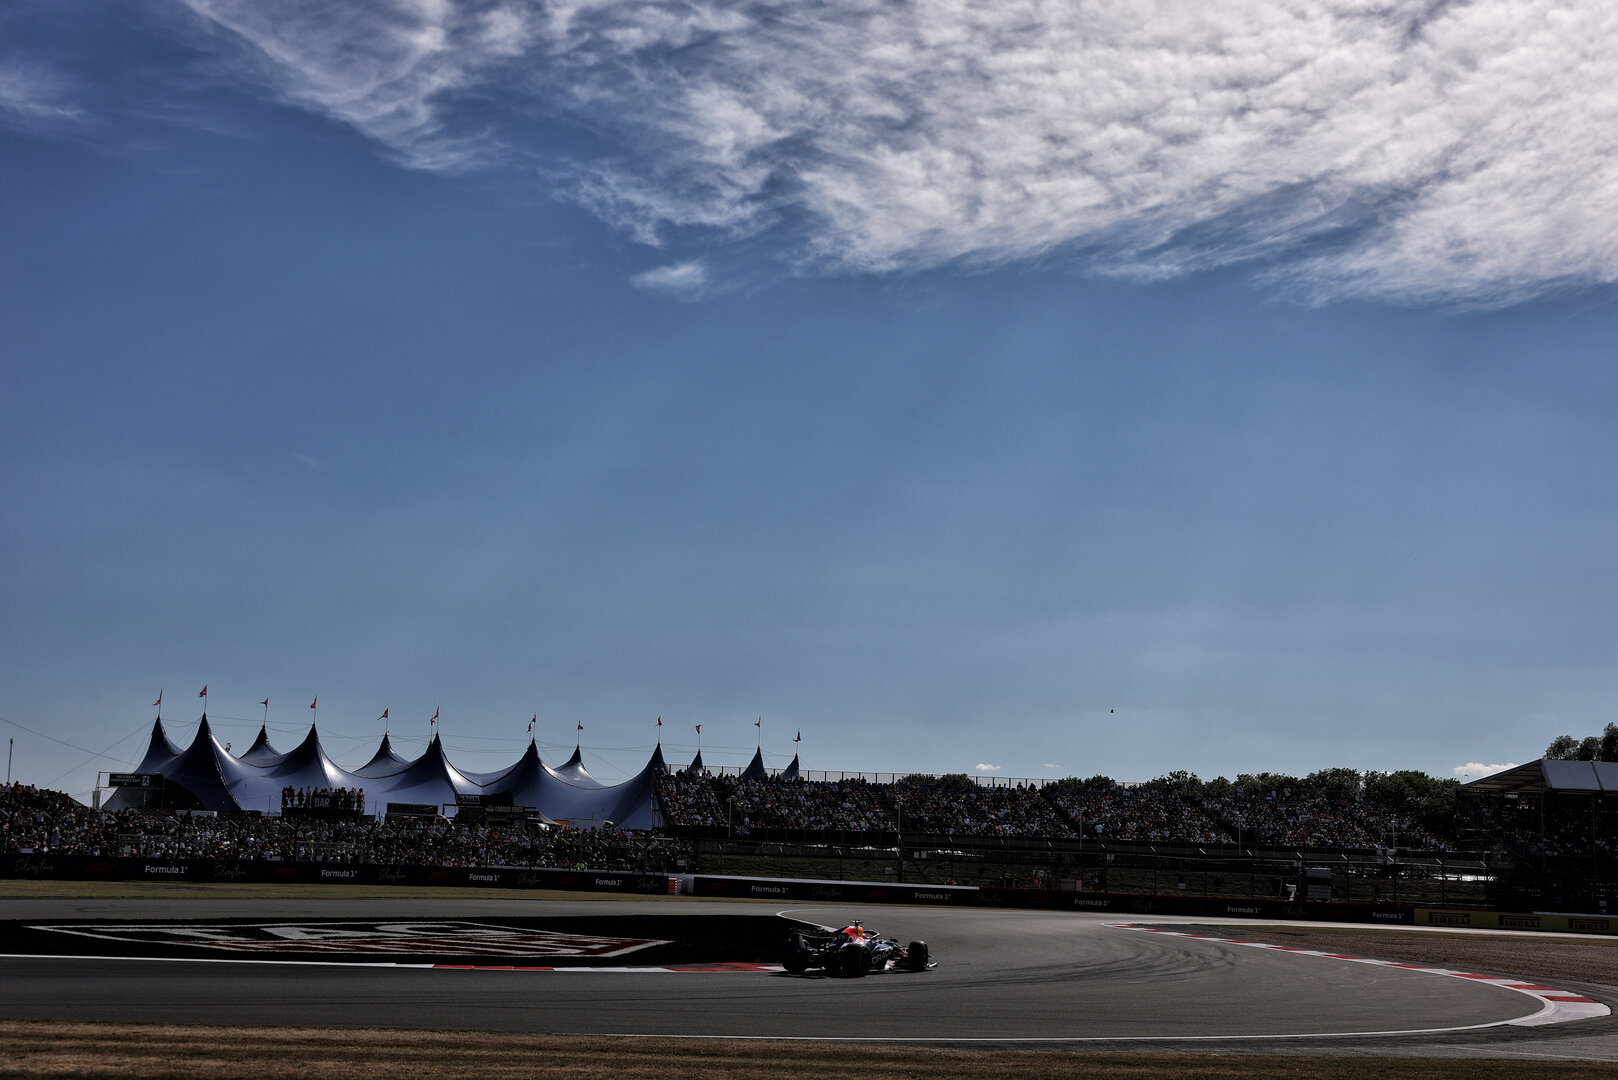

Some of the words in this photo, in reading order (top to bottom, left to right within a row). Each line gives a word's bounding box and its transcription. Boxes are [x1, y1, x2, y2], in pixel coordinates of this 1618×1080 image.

[314, 797, 330, 808] BAR
[145, 865, 179, 874] Formula
[321, 870, 349, 878] Formula
[469, 873, 493, 881] Formula
[595, 878, 616, 886] Formula
[751, 885, 781, 894] Formula
[914, 892, 943, 900] Formula
[1074, 898, 1102, 906] Formula
[1227, 906, 1254, 914] Formula
[1429, 911, 1471, 925] PIRELLI
[1498, 915, 1541, 928] PIRELLI
[1568, 918, 1610, 931] PIRELLI
[89, 924, 523, 940] TAG
